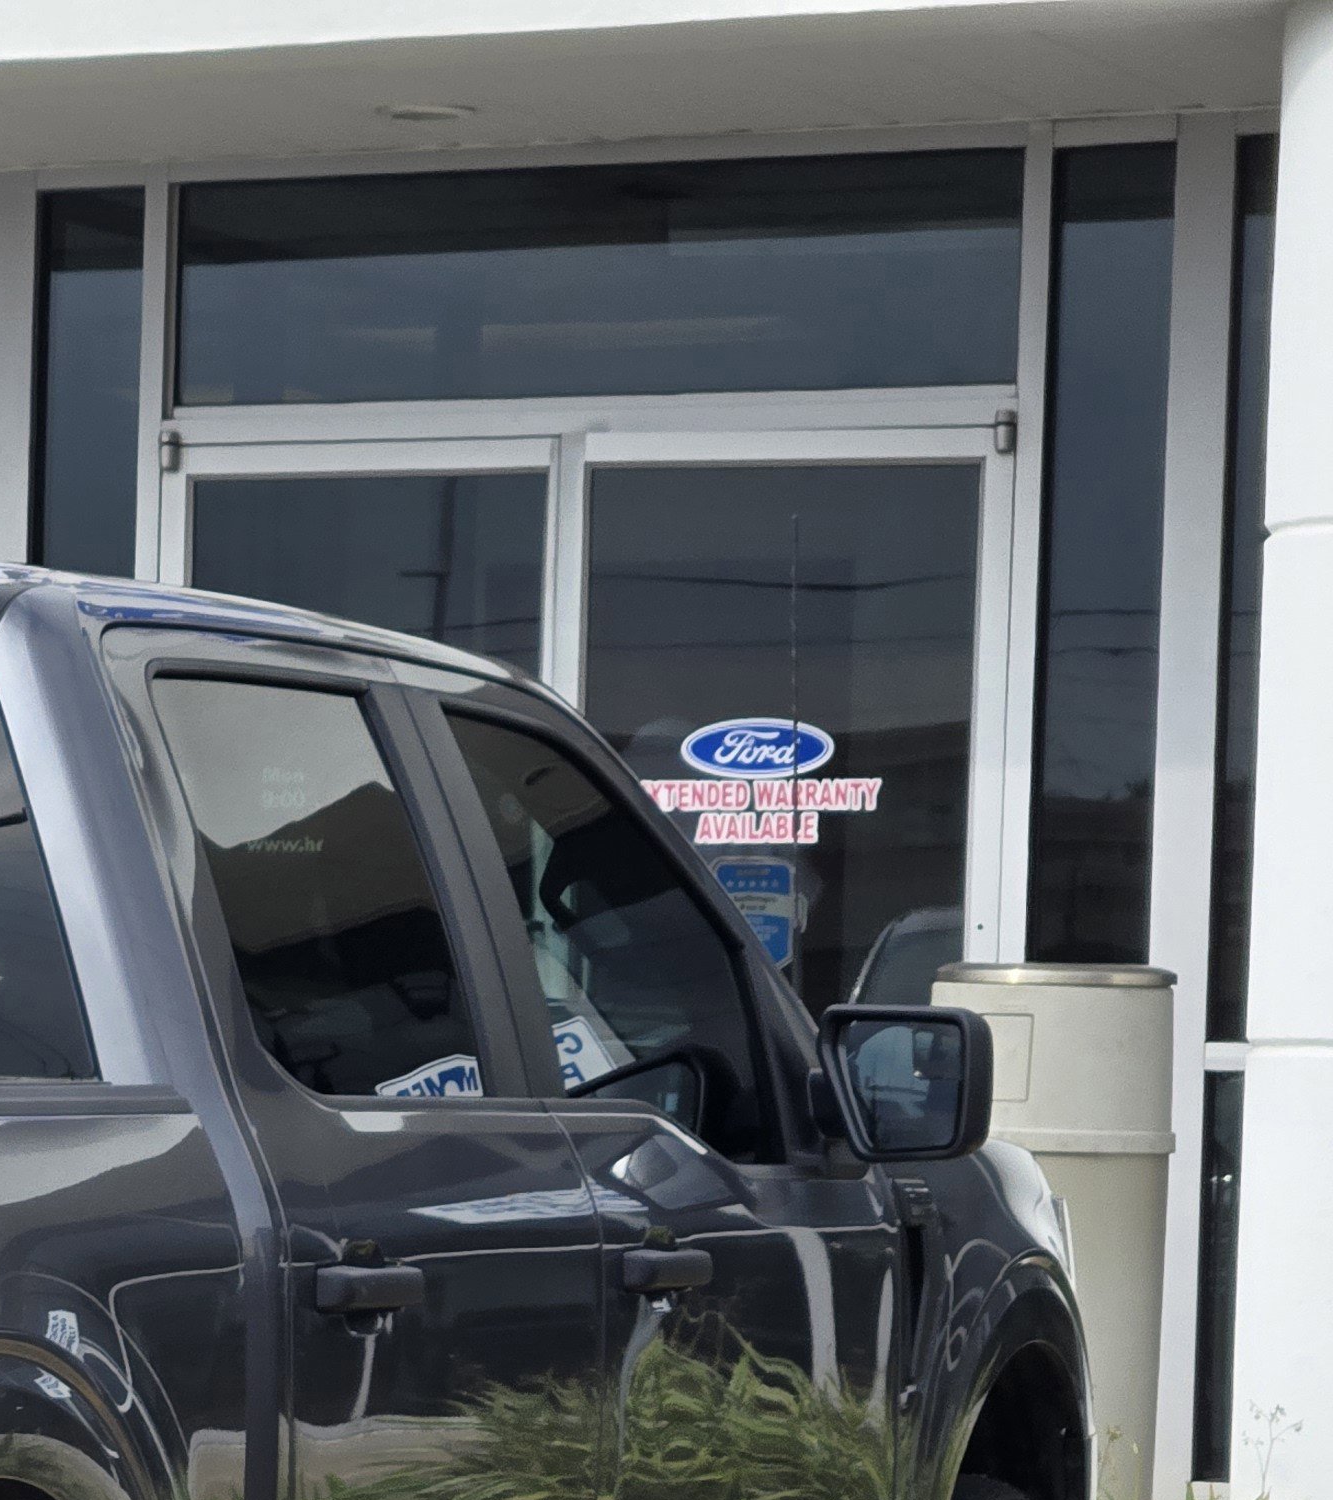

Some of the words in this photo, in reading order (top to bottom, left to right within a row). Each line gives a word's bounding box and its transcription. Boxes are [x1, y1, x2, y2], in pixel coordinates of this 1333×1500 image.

[714, 729, 800, 765] Ford
[754, 779, 881, 810] WARRANTY
[697, 812, 818, 842] AVAILABLE
